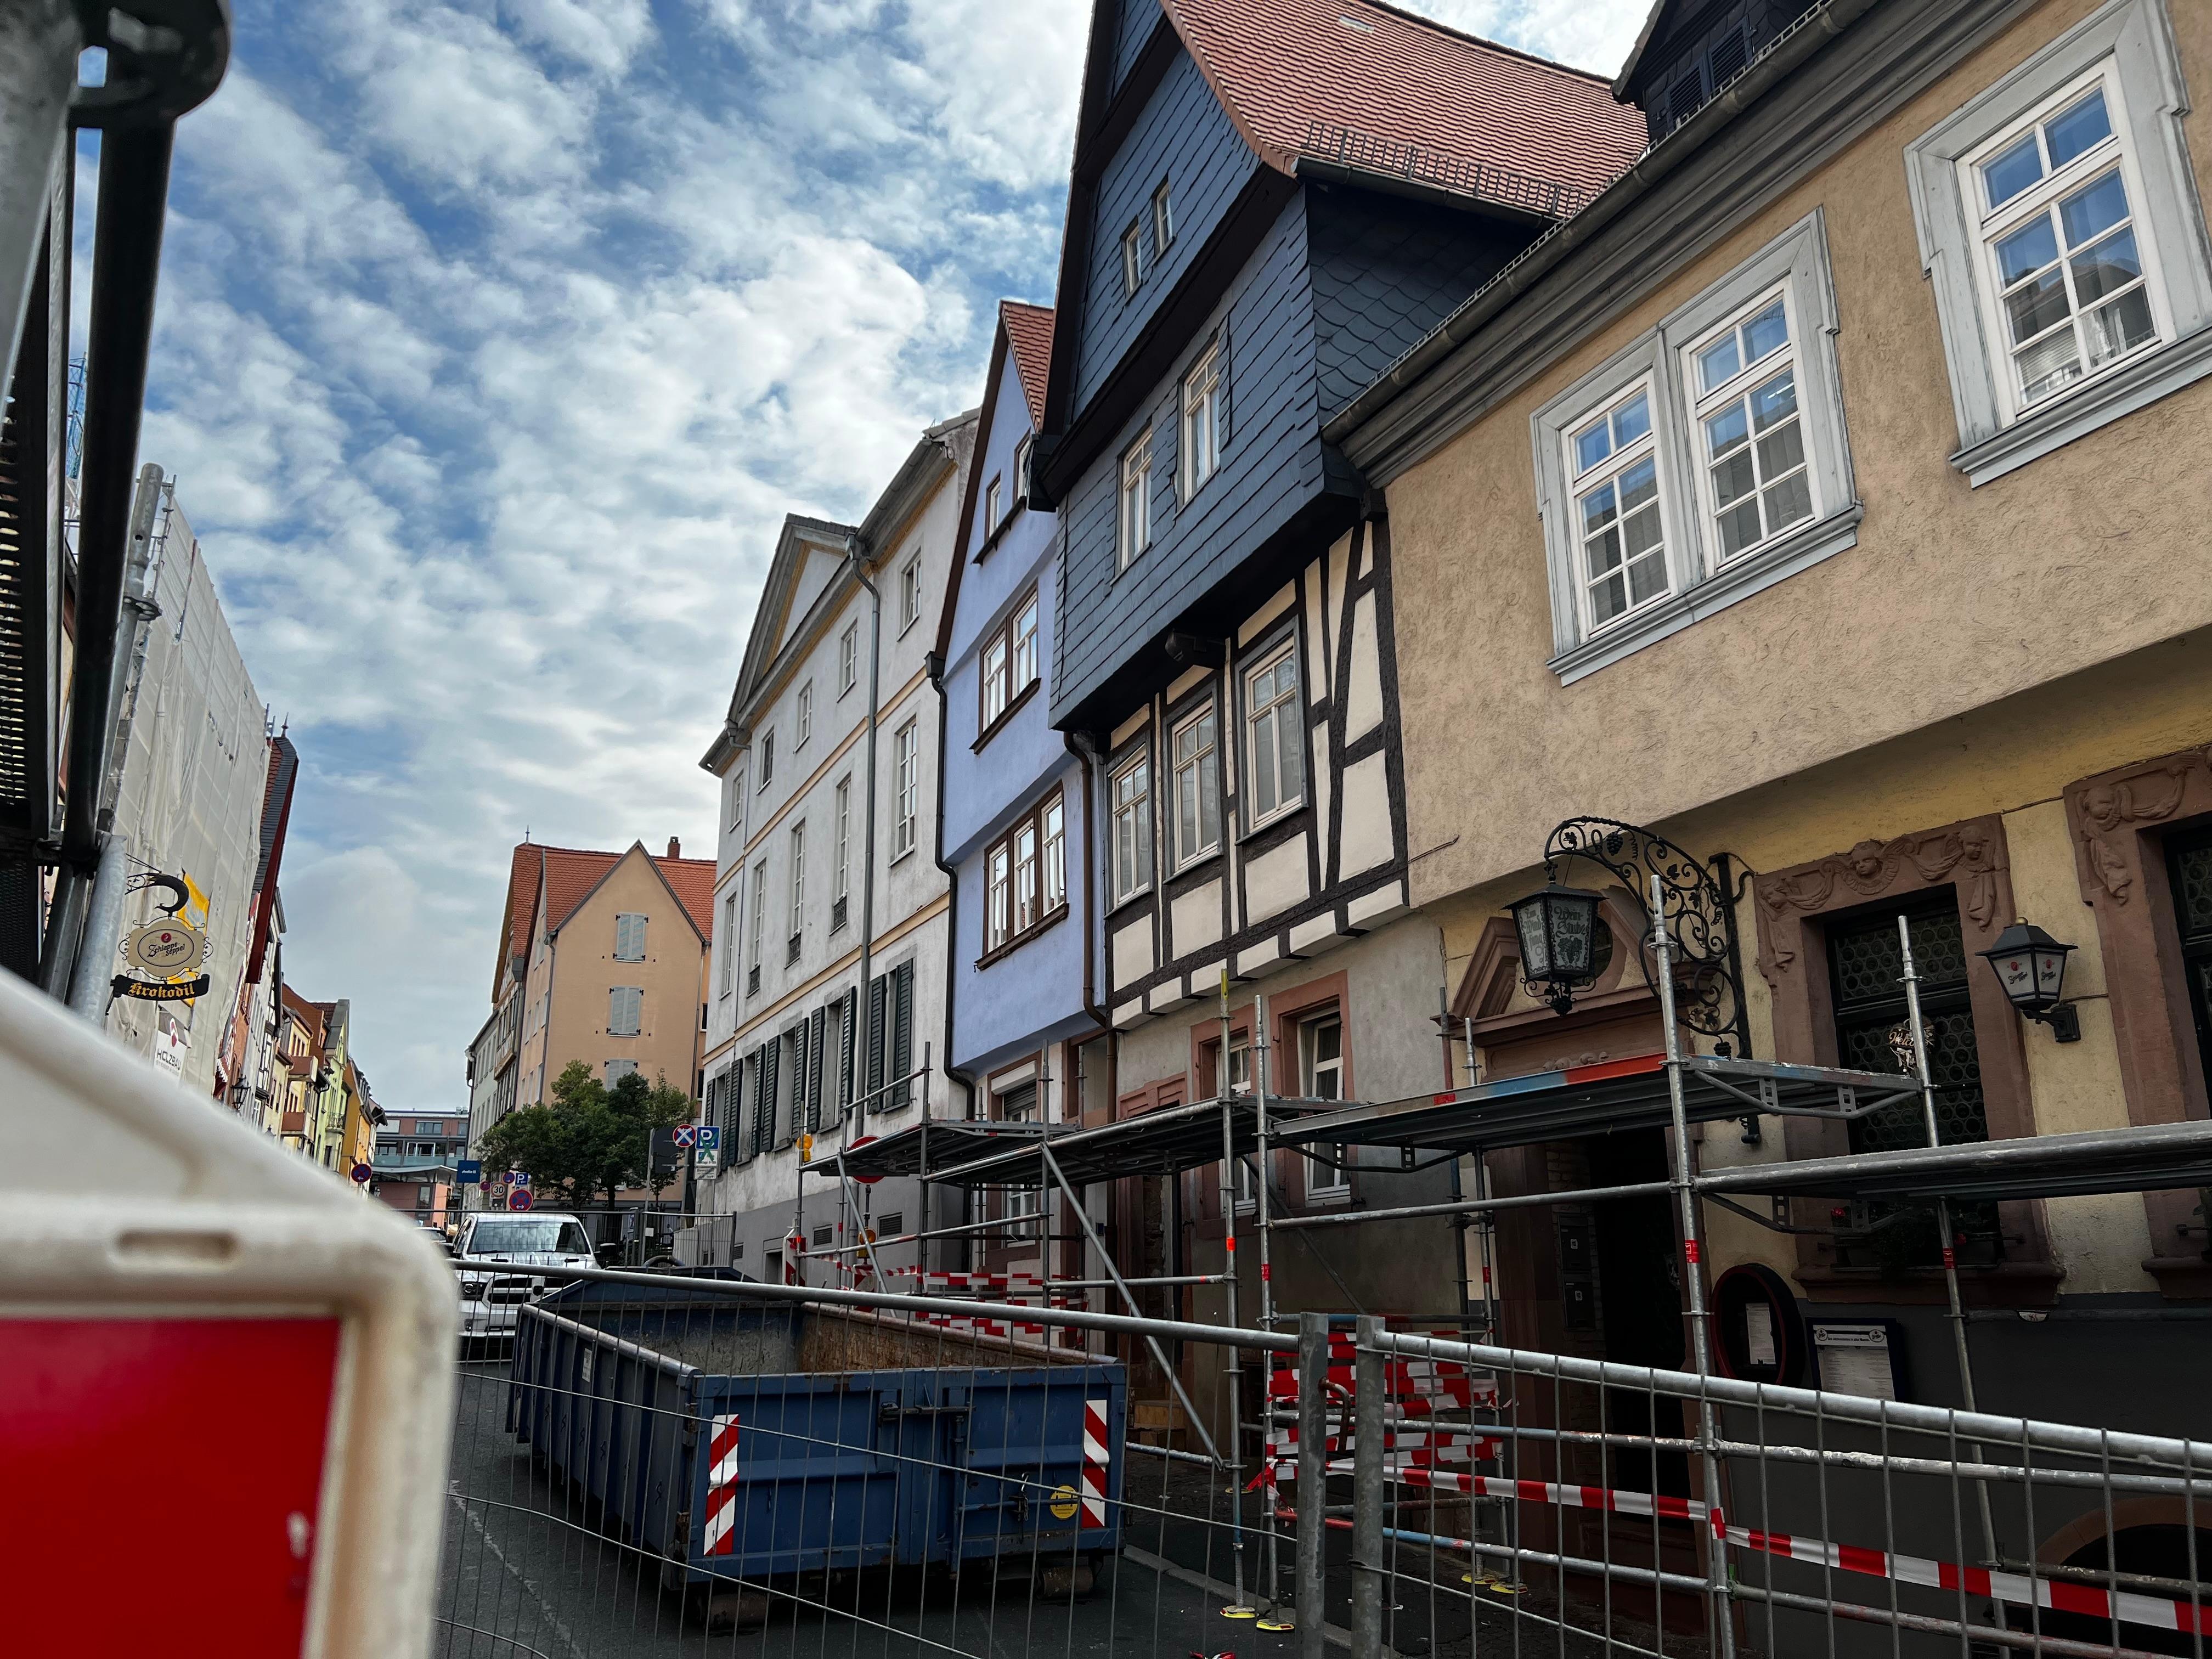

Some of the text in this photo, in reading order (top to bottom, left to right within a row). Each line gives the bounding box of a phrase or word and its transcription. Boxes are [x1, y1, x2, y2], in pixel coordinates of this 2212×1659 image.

[128, 982, 195, 998] Krokodil
[1889, 1031, 1915, 1047] Welco
[699, 1129, 713, 1147] P
[517, 1174, 524, 1184] P
